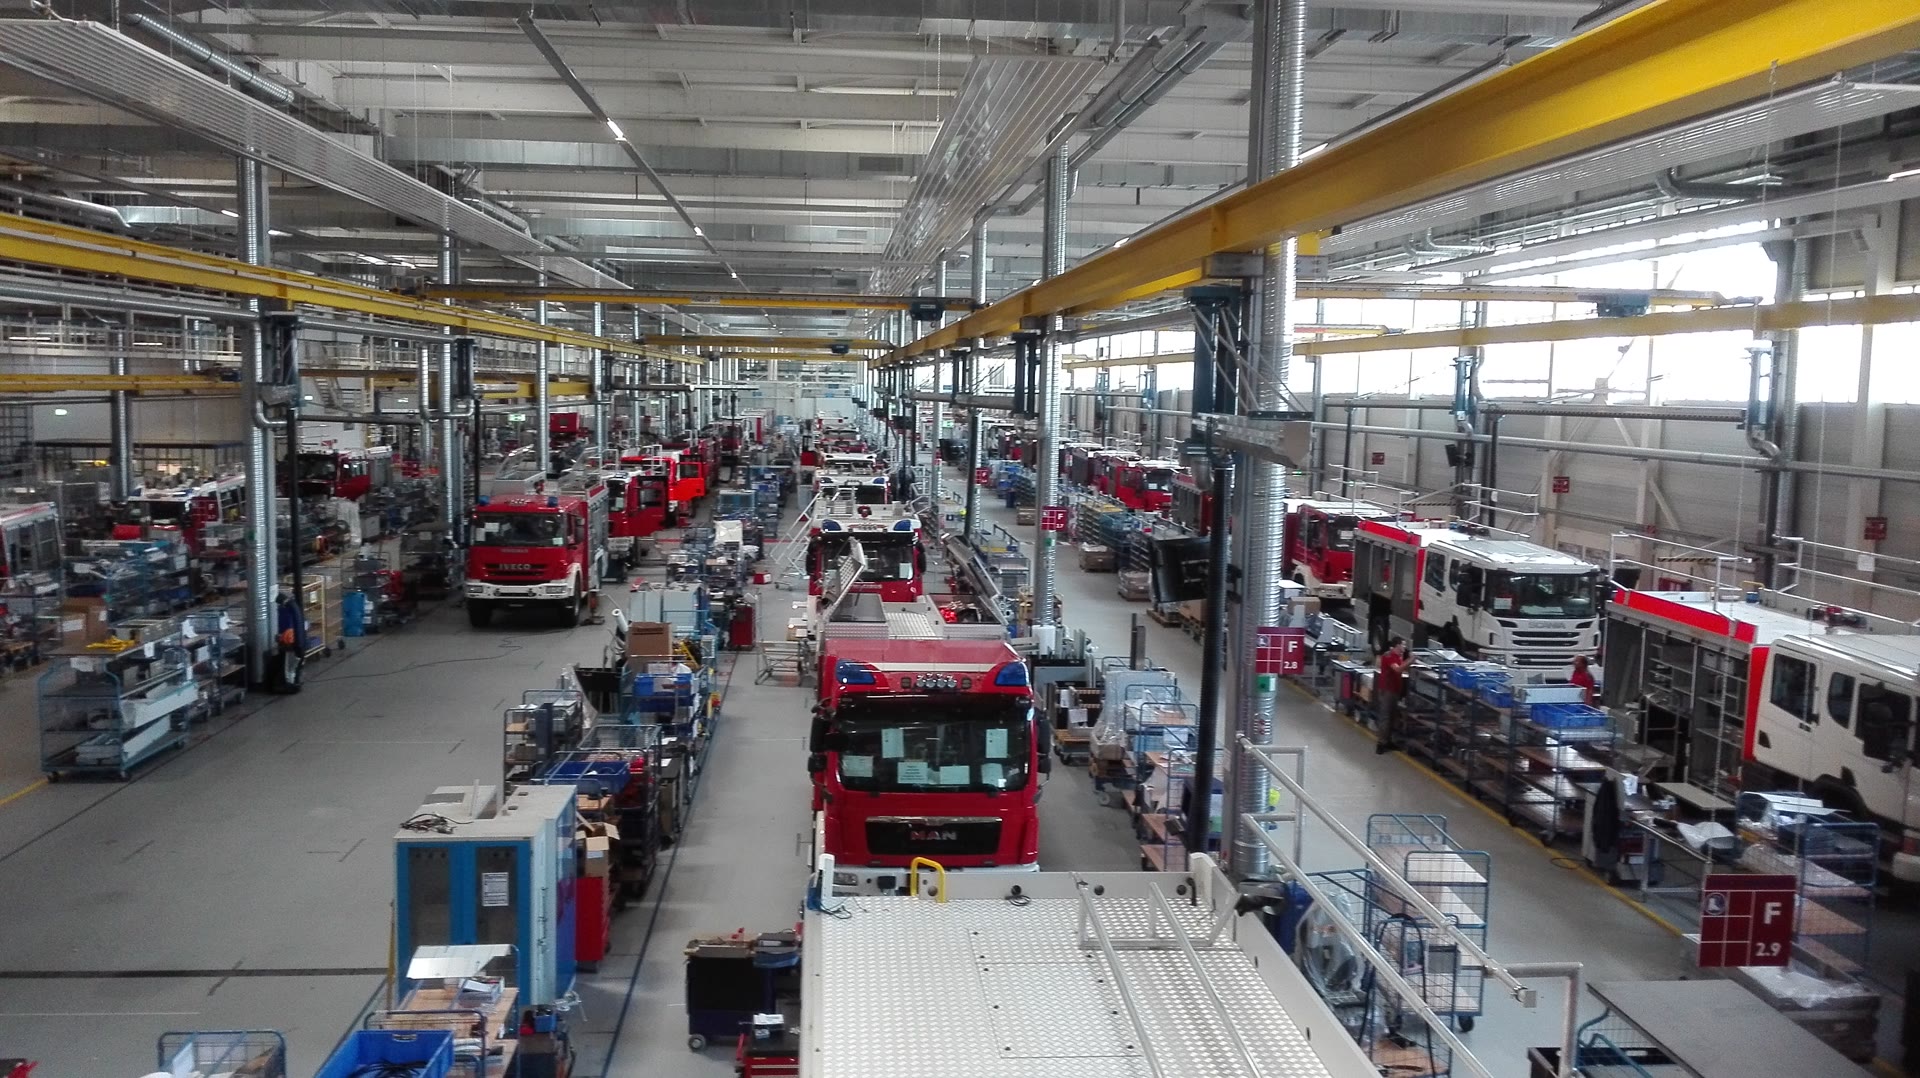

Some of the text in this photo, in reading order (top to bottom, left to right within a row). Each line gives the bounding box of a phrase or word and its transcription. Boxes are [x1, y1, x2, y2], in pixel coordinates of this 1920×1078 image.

[499, 563, 532, 571] IVECO
[1288, 640, 1298, 653] F
[1283, 661, 1298, 669] 2.8
[910, 831, 957, 841] MAN
[1763, 901, 1782, 925] F
[1755, 942, 1781, 957] 2.9
